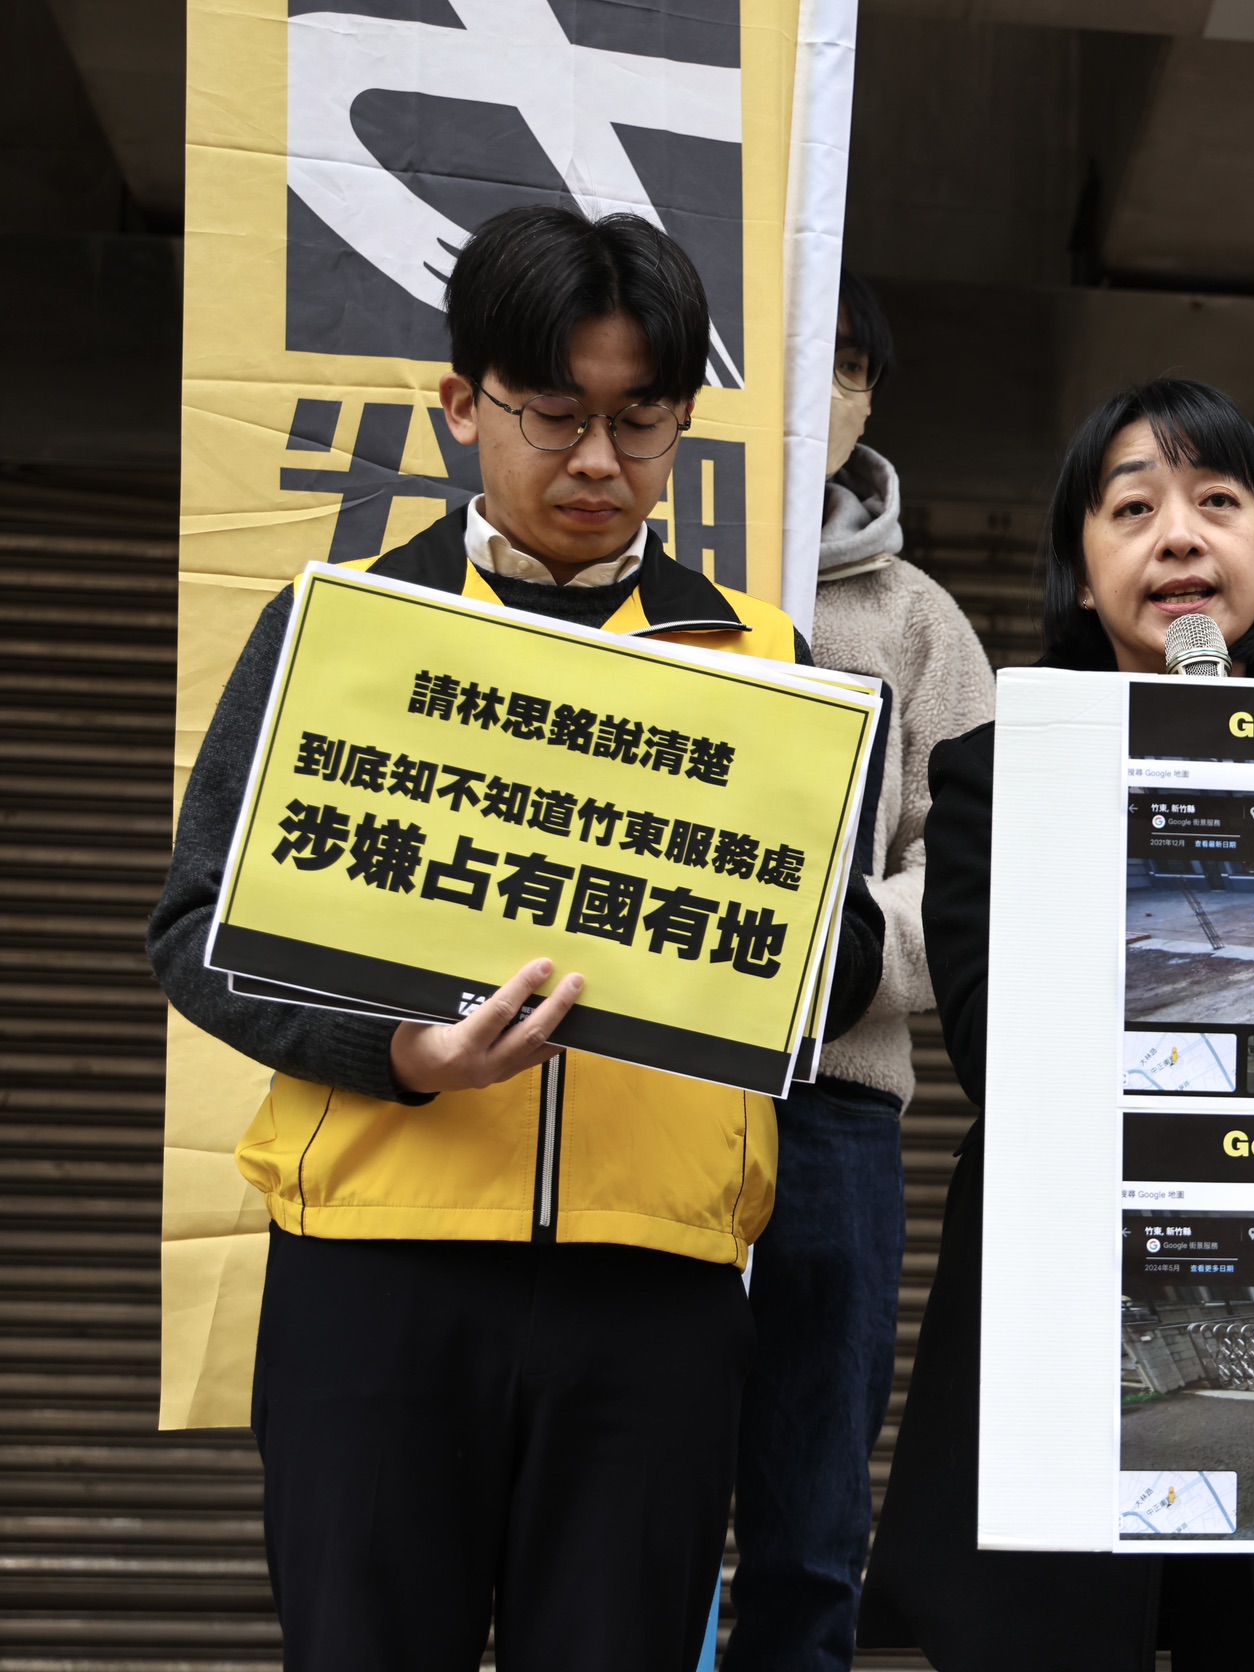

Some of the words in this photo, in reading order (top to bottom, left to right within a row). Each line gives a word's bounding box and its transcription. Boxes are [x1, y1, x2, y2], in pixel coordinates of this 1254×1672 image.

[408, 670, 736, 787] 請林思銘說清楚
[1145, 769, 1172, 779] Google
[294, 731, 806, 892] 到底知不知道竹東服務處
[1168, 818, 1191, 827] Google
[272, 799, 788, 980] 涉嫌占有國有地
[1138, 1190, 1166, 1200] Google
[1163, 1242, 1188, 1251] Google
[1144, 1264, 1180, 1273] 2024年5月
